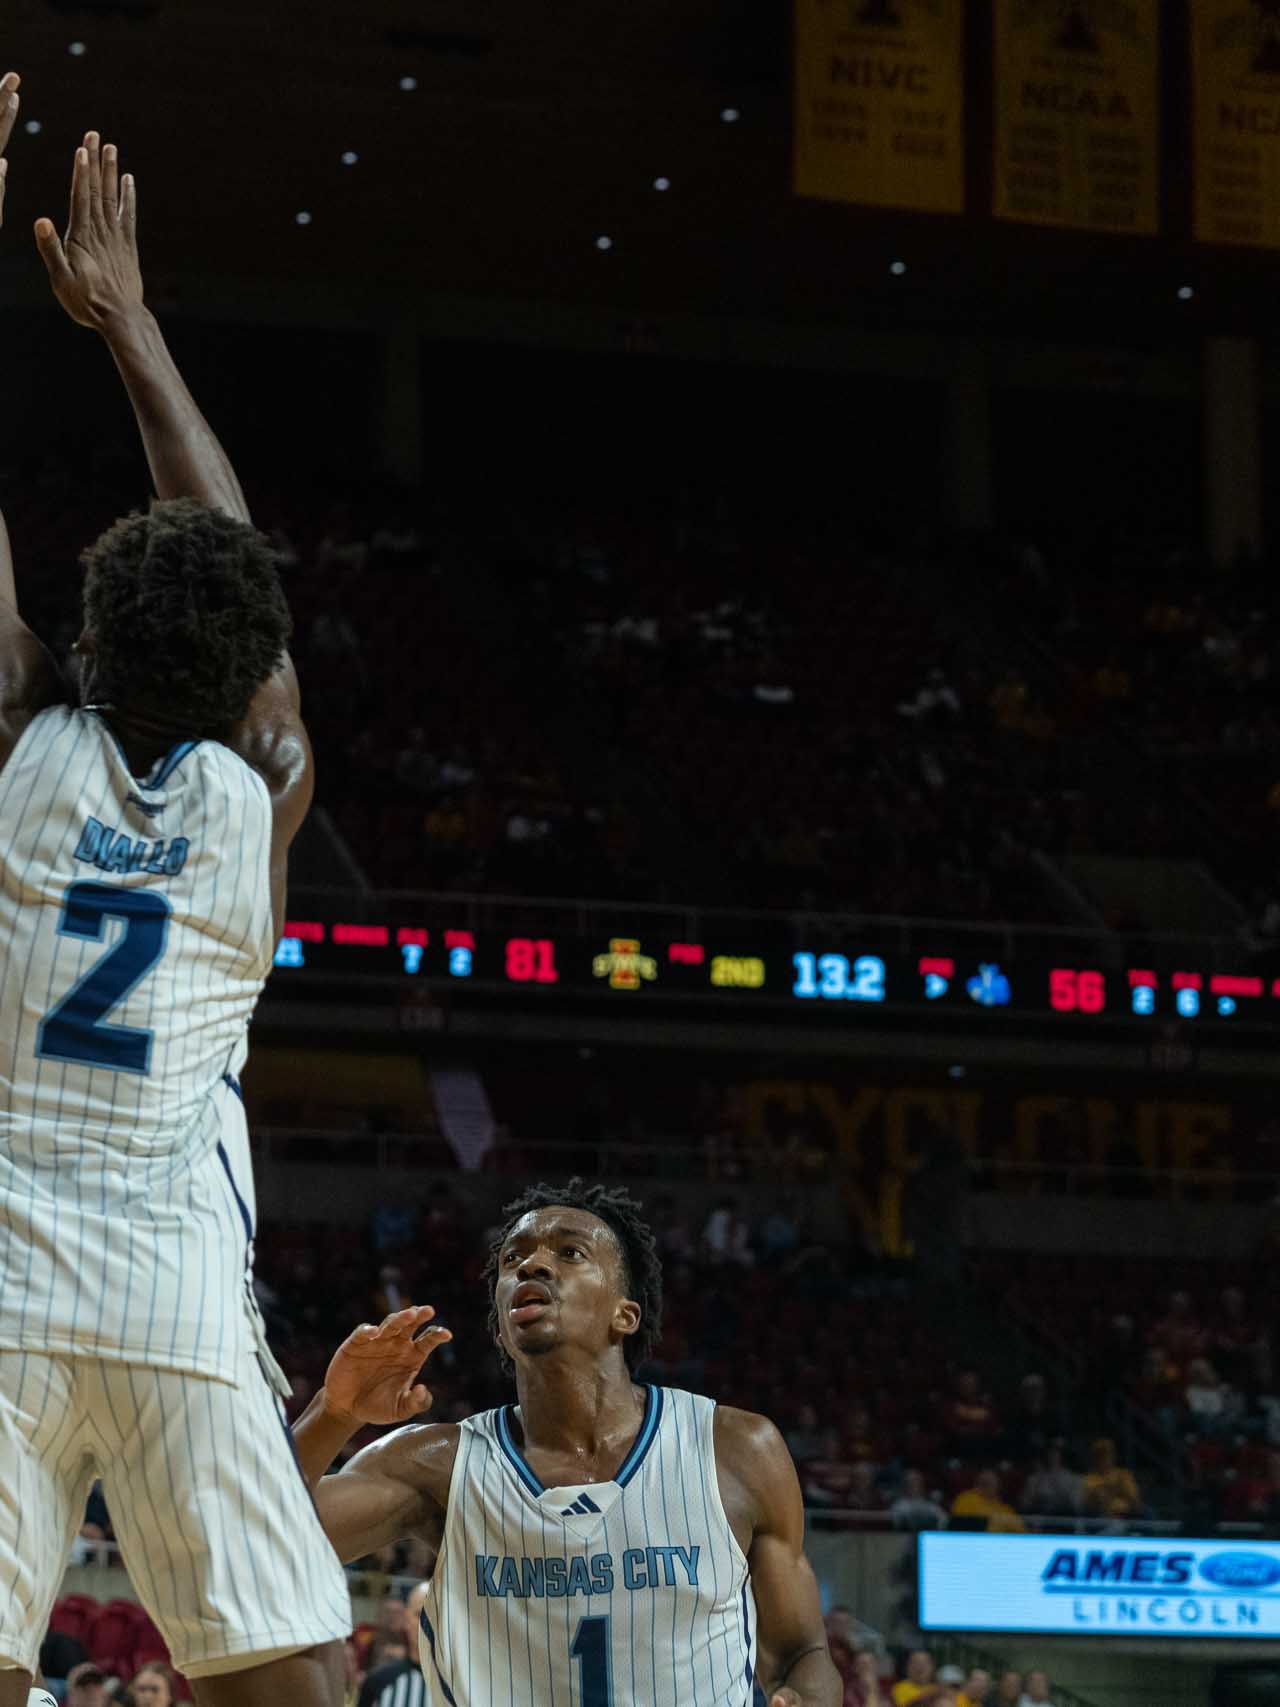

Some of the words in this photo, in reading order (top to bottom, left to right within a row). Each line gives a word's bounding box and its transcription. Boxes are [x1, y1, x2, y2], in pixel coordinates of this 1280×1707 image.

[72, 815, 191, 876] DIALLO
[34, 878, 174, 1077] 2
[505, 938, 559, 983] 81
[792, 951, 886, 1001] 13.2
[1048, 968, 1106, 1013] 56
[475, 1552, 615, 1599] KANSAS
[622, 1545, 701, 1591] CITY
[1039, 1548, 1195, 1584] AMES
[1073, 1598, 1261, 1626] LINCOLN
[569, 1613, 611, 1707] 1
